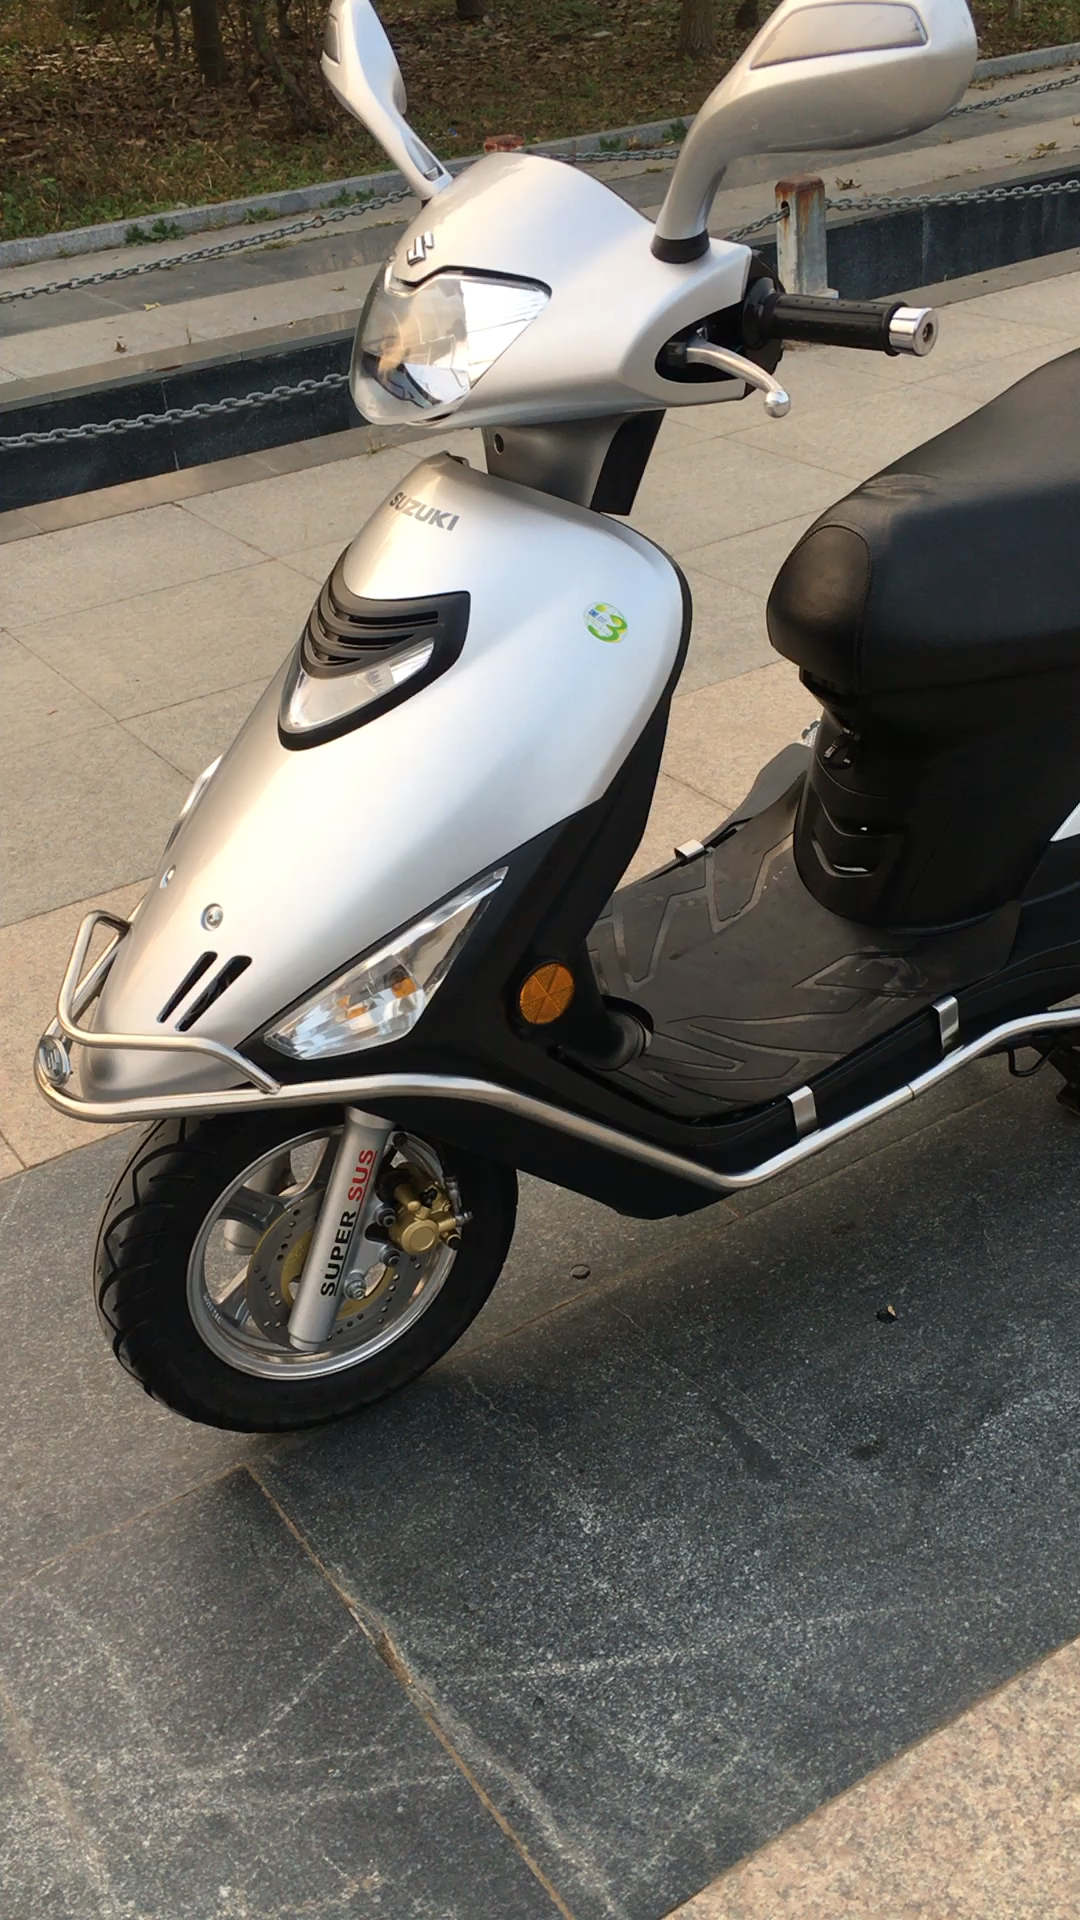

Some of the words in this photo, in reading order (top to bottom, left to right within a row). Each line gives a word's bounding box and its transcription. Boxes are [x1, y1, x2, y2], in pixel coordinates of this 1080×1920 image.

[389, 491, 460, 531] SUZUKI
[320, 1210, 357, 1297] SUPER
[347, 1149, 374, 1202] SUS
